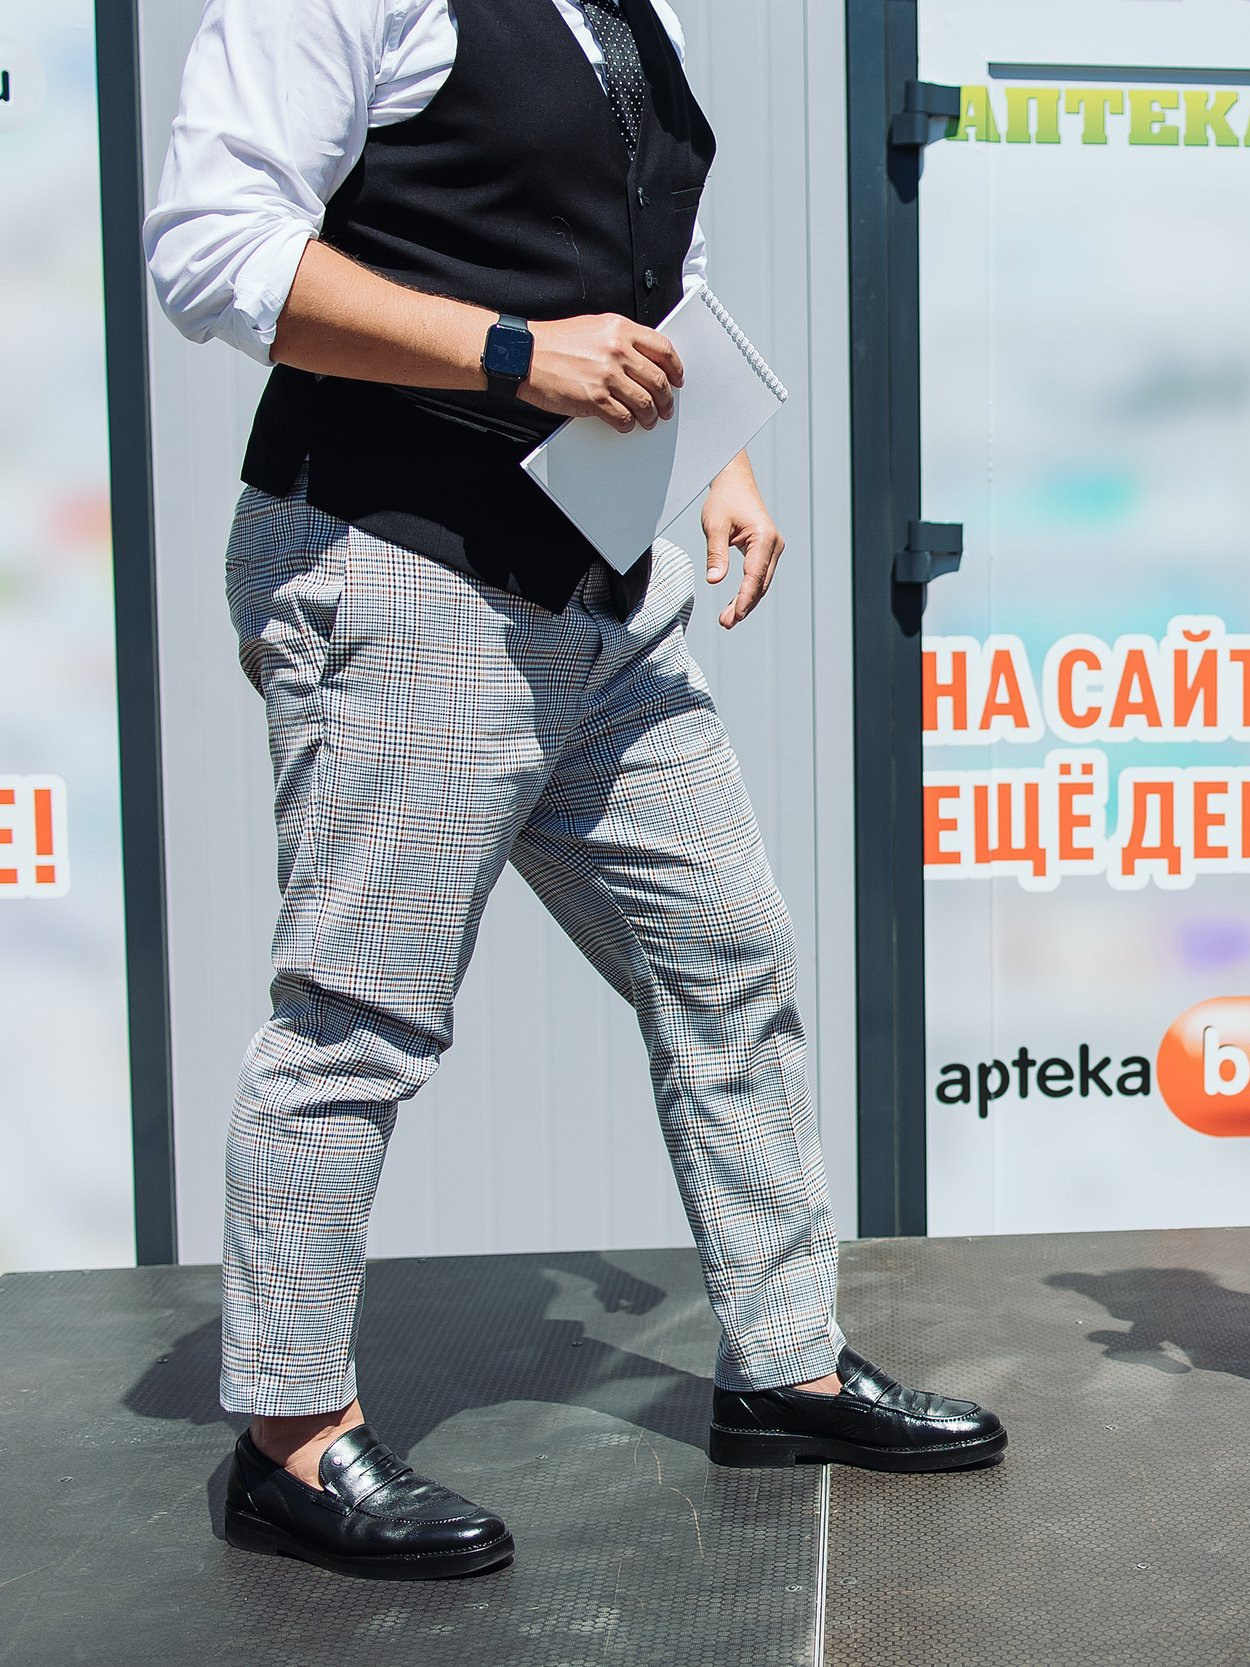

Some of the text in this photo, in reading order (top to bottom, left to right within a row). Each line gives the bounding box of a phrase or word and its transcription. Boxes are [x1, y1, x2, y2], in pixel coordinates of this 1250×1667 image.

[922, 649, 1029, 731] НА
[923, 763, 1094, 877] ЕЩЁ
[936, 1044, 1151, 1118] apteka
